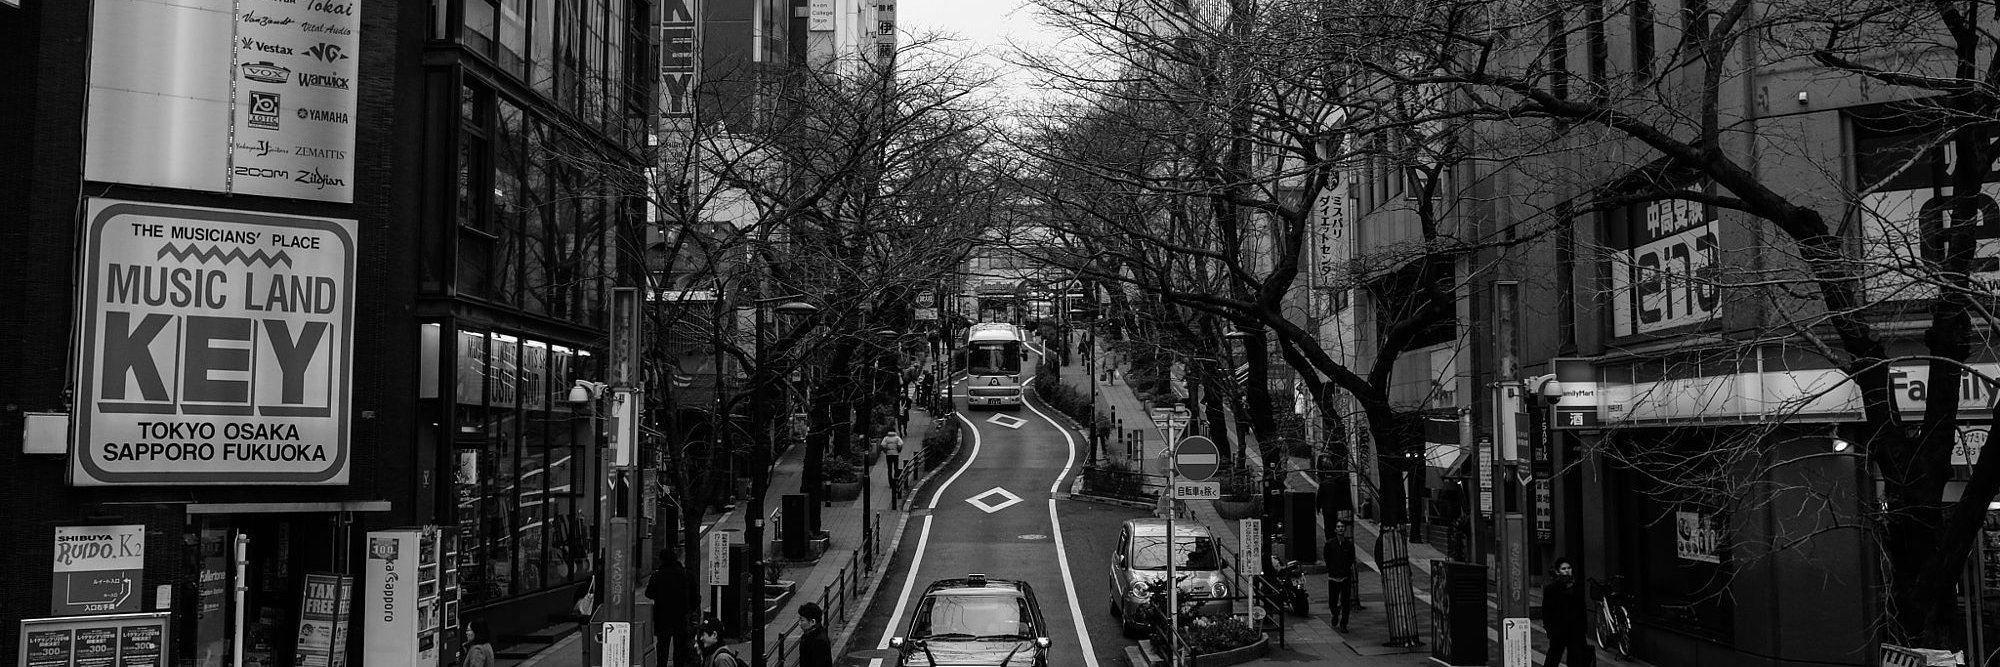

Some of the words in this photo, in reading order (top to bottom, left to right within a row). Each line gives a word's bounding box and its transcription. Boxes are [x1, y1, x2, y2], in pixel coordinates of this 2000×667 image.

[307, 0, 353, 16] Tokai
[301, 22, 325, 33] Vital
[325, 25, 351, 36] Audio
[256, 41, 293, 55] Vestax
[249, 68, 283, 78] VOX
[298, 72, 349, 90] Warwick
[309, 109, 349, 124] YAMAHA
[295, 146, 345, 160] ZEMAITIS
[235, 166, 289, 180] ZOOM
[295, 167, 345, 190] Zildjian
[132, 223, 163, 239] THE
[272, 234, 320, 250] PLACE
[107, 263, 227, 310] MUSIC
[245, 271, 336, 314] LAND
[98, 311, 333, 412] KEY
[1563, 390, 1594, 398] amilyMart
[1889, 371, 2000, 410] Faily
[1570, 412, 1583, 426] 酒
[138, 422, 215, 440] TOKYO
[224, 423, 300, 441] OSAKA
[103, 442, 215, 461] SAPPORO
[223, 443, 327, 462] FUKUOKA
[1178, 486, 1217, 497] 自転車を除く
[309, 583, 335, 599] TAX
[306, 598, 334, 614] FREE
[42, 647, 60, 656] 300
[89, 645, 107, 653] 300
